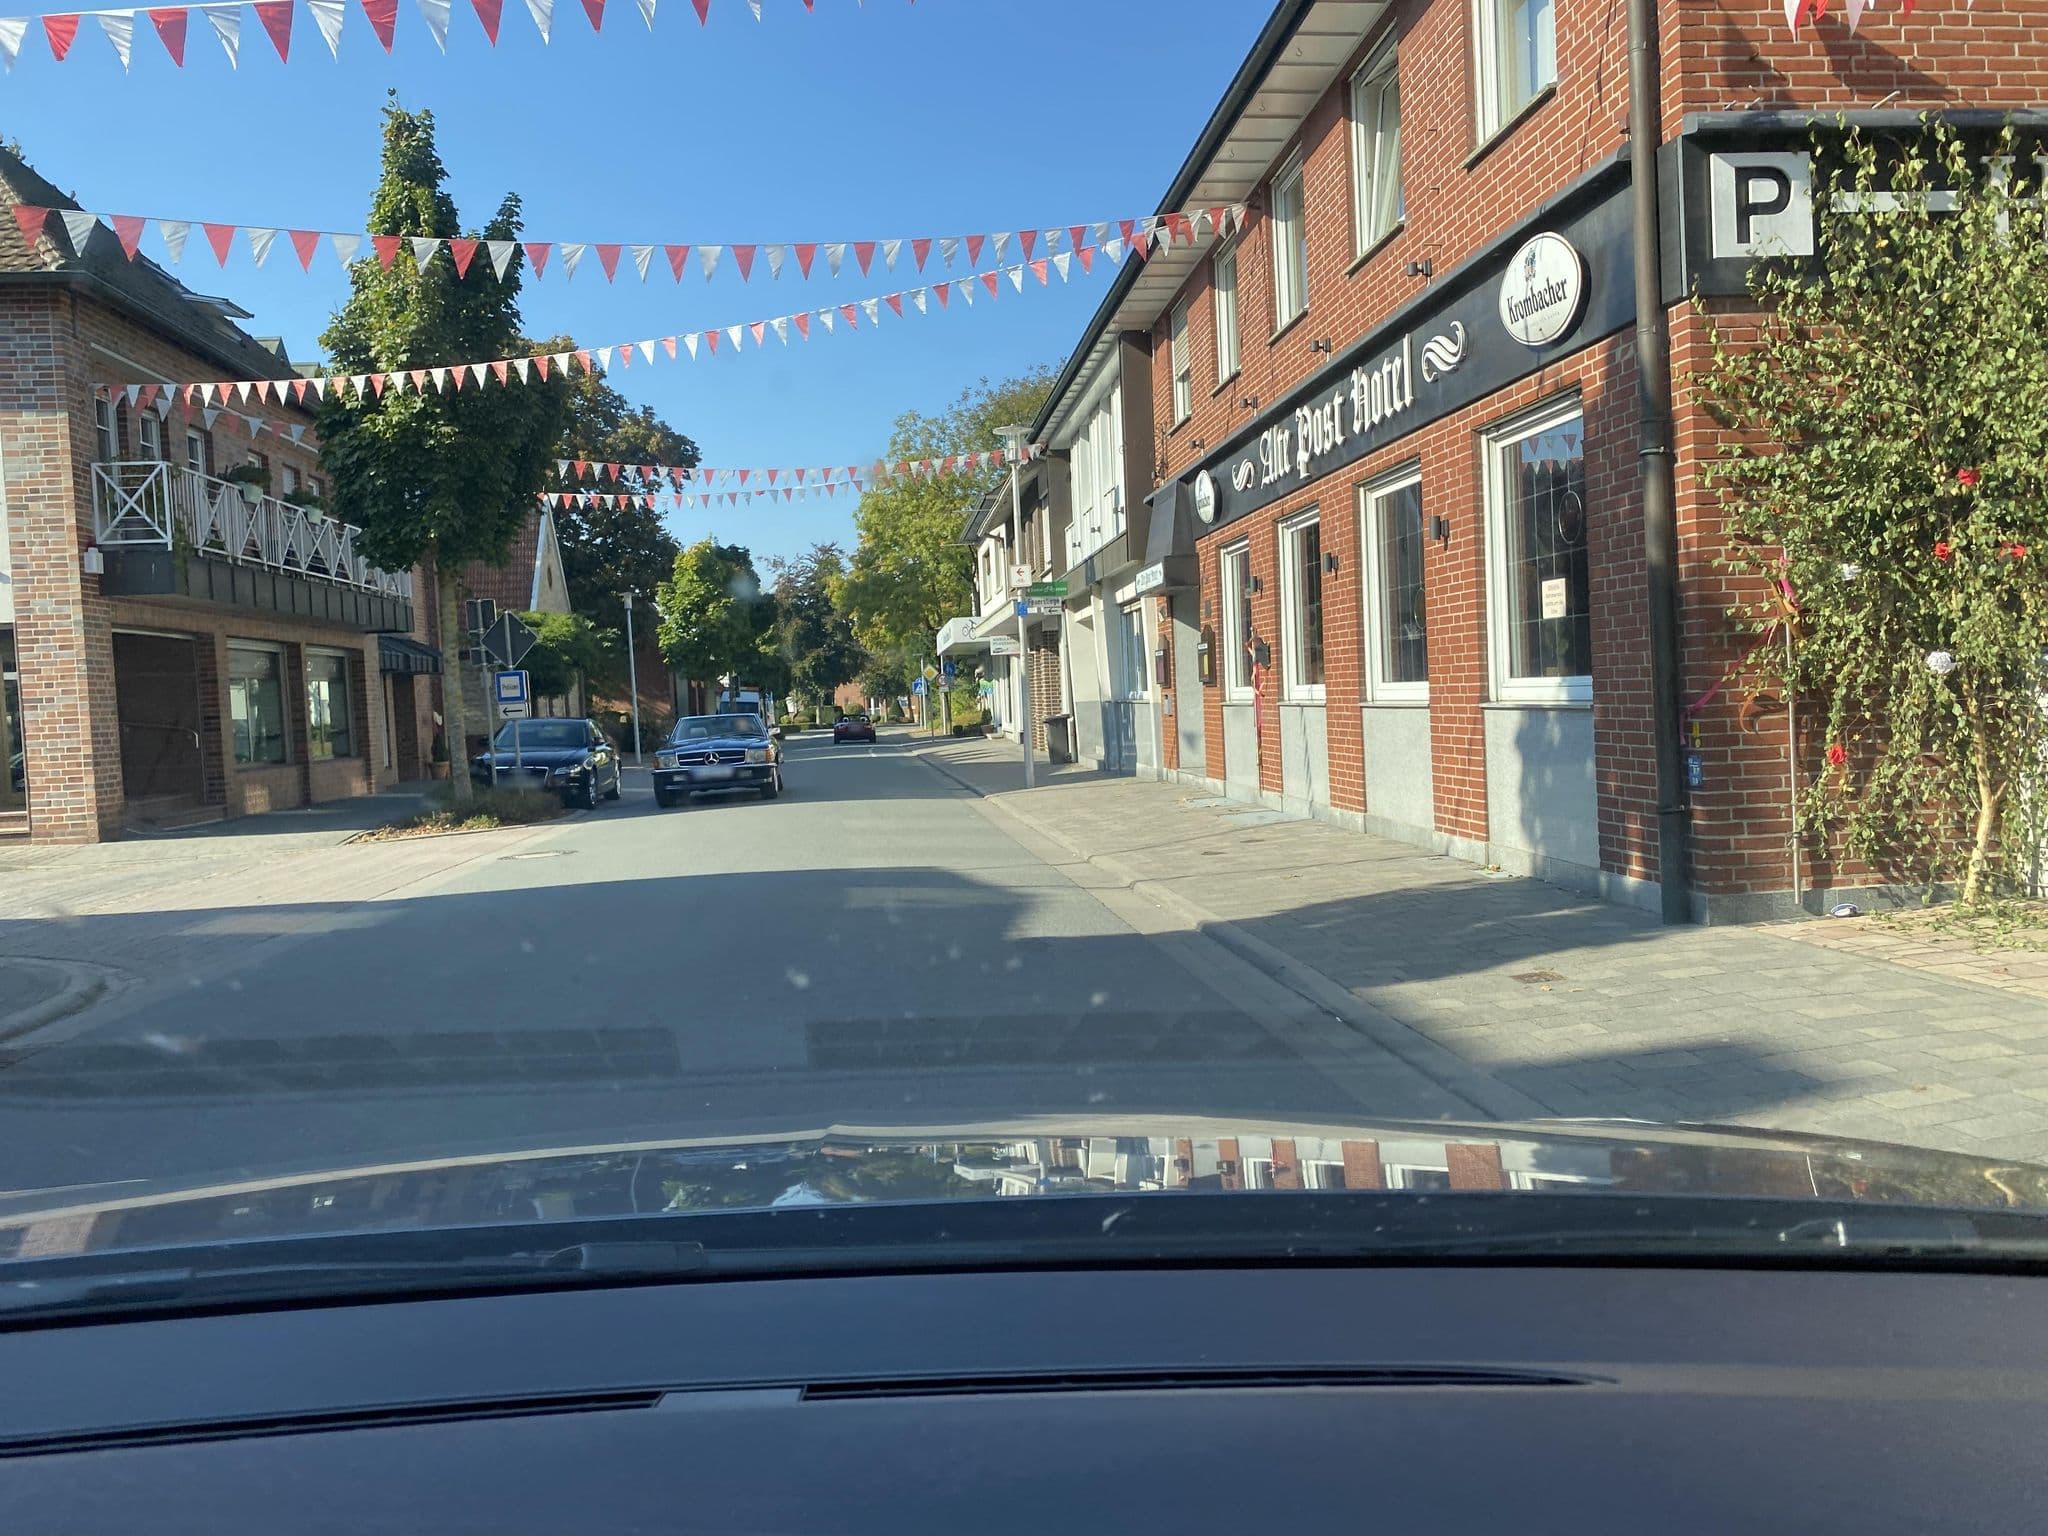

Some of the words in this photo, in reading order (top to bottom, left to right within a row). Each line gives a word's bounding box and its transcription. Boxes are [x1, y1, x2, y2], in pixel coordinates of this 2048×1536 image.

[1735, 165, 1791, 244] P
[1507, 276, 1568, 325] Krombacher
[1259, 423, 1292, 490] Alte
[1295, 389, 1346, 480] Post
[1350, 332, 1414, 435] Hotel
